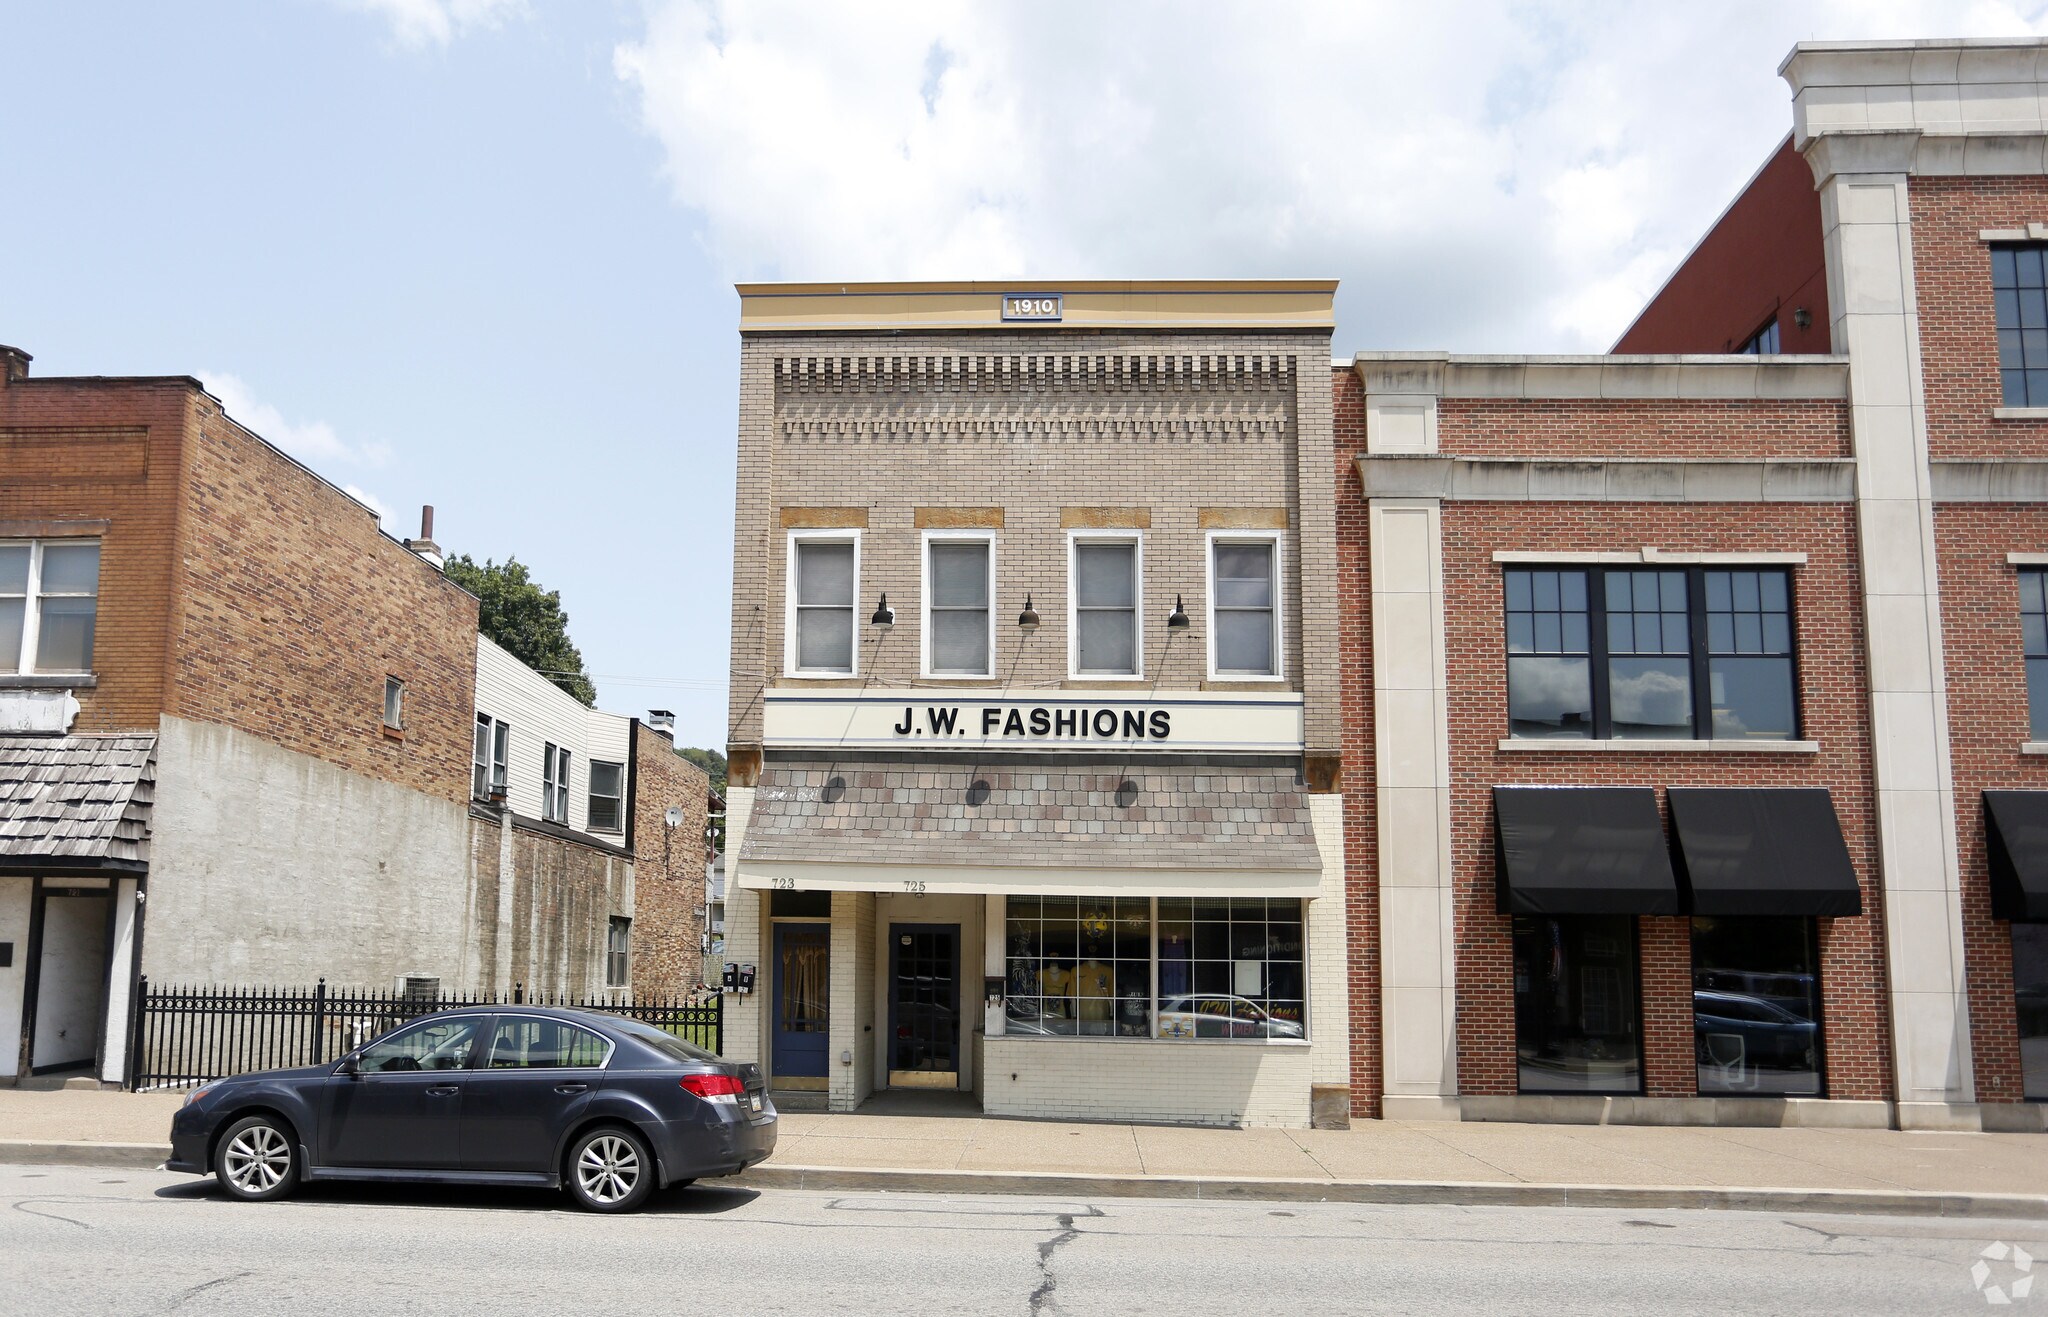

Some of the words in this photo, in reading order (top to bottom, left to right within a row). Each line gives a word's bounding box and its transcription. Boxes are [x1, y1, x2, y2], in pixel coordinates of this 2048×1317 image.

[1013, 299, 1053, 313] 1910
[895, 707, 965, 735] J.W.
[982, 707, 1171, 738] FASHIONS
[771, 878, 795, 889] 723
[904, 880, 926, 892] 725
